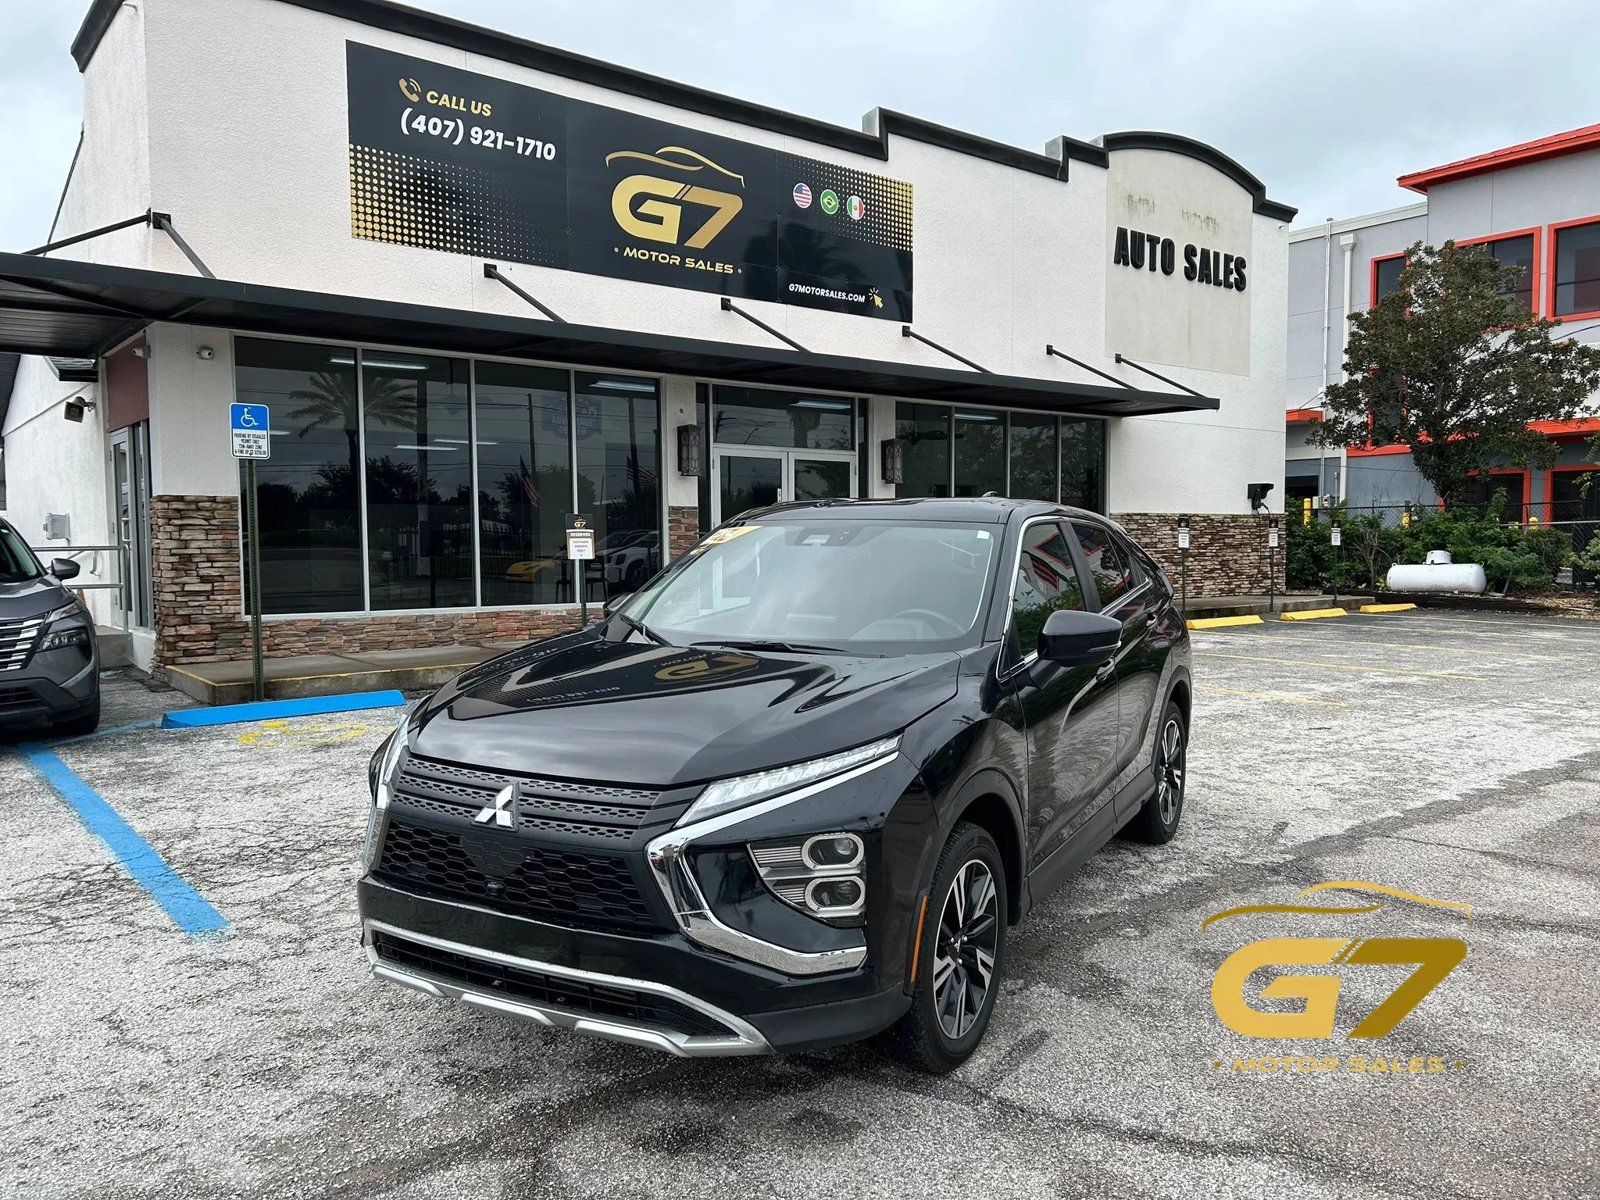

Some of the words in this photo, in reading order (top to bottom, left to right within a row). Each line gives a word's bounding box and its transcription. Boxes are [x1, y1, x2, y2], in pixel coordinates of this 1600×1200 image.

[426, 90, 467, 112] CALL
[470, 100, 493, 117] US
[400, 107, 464, 146] (407)
[469, 126, 556, 161] 921-1710
[611, 174, 744, 249] G7
[623, 246, 681, 266] MOTOR
[685, 257, 734, 274] SALES
[1113, 226, 1175, 276] AUTO
[1184, 243, 1247, 292] SALES
[788, 283, 866, 303] G7MOTORSALES.COM
